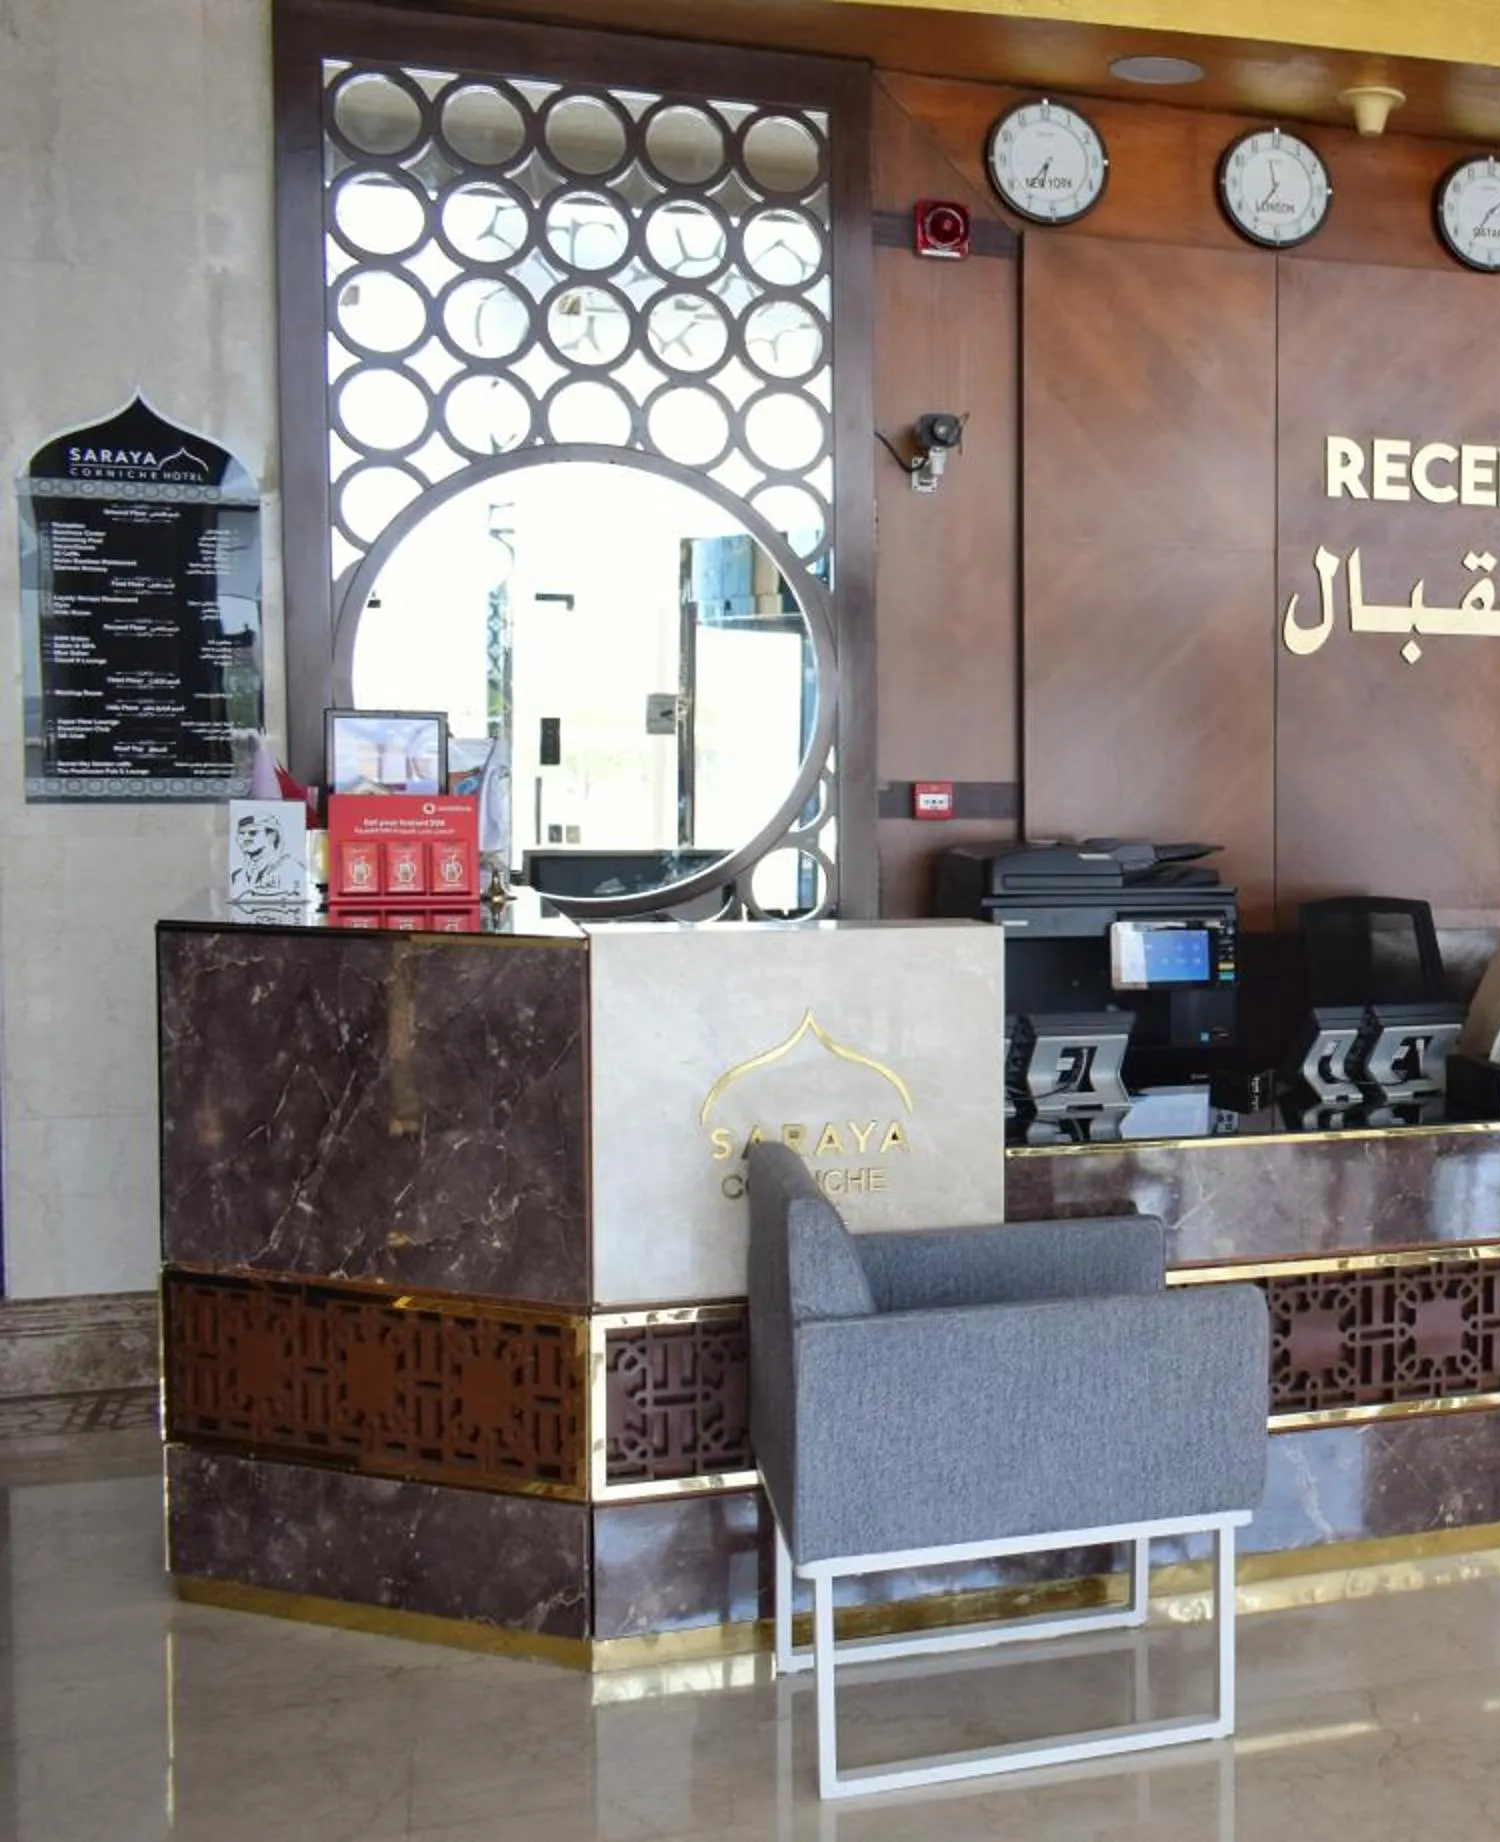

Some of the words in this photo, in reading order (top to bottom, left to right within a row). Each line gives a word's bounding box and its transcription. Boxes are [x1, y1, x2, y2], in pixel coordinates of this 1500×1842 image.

[1025, 177, 1046, 189] NEW
[1047, 177, 1072, 189] YORK
[1255, 199, 1295, 213] LONDON
[69, 447, 157, 465] SARAYA
[70, 467, 160, 479] CORNICHE
[162, 470, 205, 482] HOTEL
